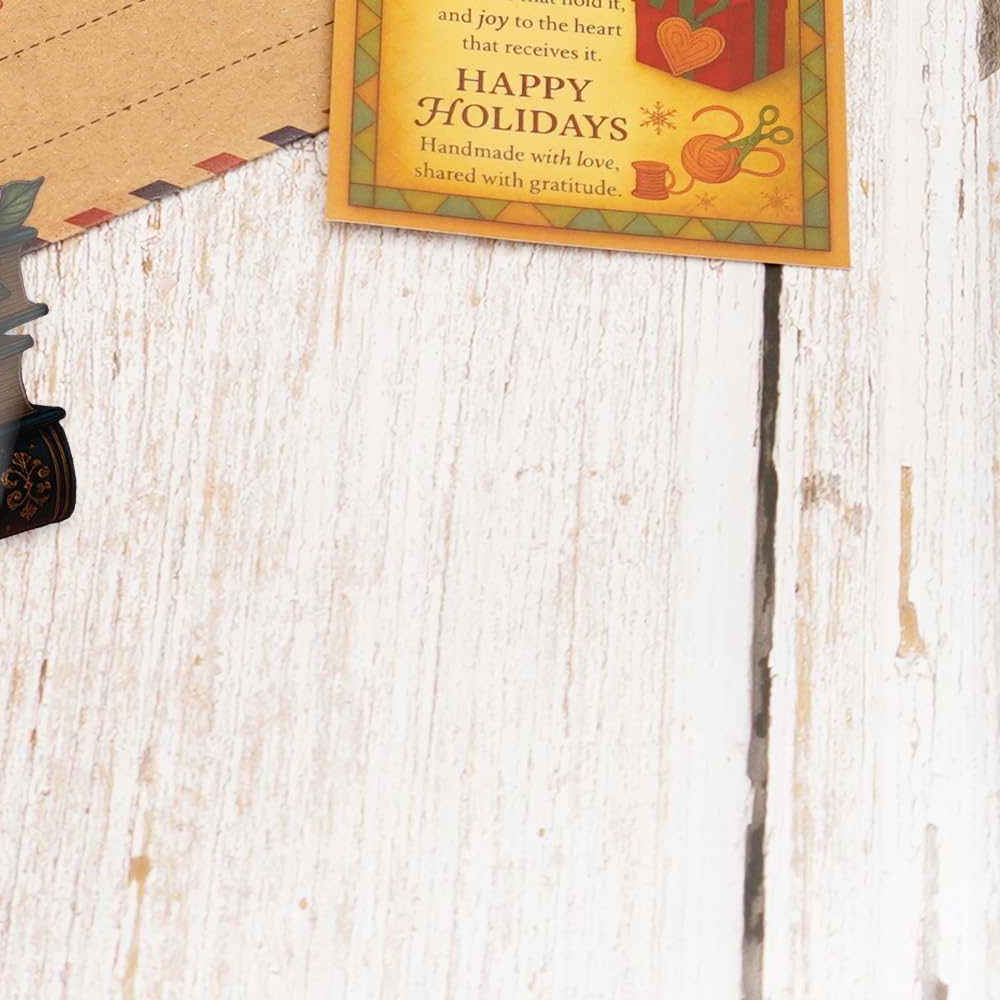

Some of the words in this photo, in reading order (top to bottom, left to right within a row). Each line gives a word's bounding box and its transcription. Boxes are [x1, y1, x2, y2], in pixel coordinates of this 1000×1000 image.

[438, 8, 472, 24] and
[476, 9, 509, 32] joy
[515, 15, 534, 29] to
[539, 15, 568, 33] the
[574, 18, 623, 37] heart
[462, 34, 499, 53] that
[505, 42, 579, 61] receives
[584, 46, 603, 62] it.
[456, 67, 594, 103] HAPPY
[414, 96, 629, 142] HOLIDAYS
[420, 136, 525, 162] Handmade
[530, 148, 571, 166] with
[577, 150, 621, 172] love,
[414, 162, 476, 184] shared
[482, 171, 523, 189] with
[529, 177, 623, 198] gratitude.
